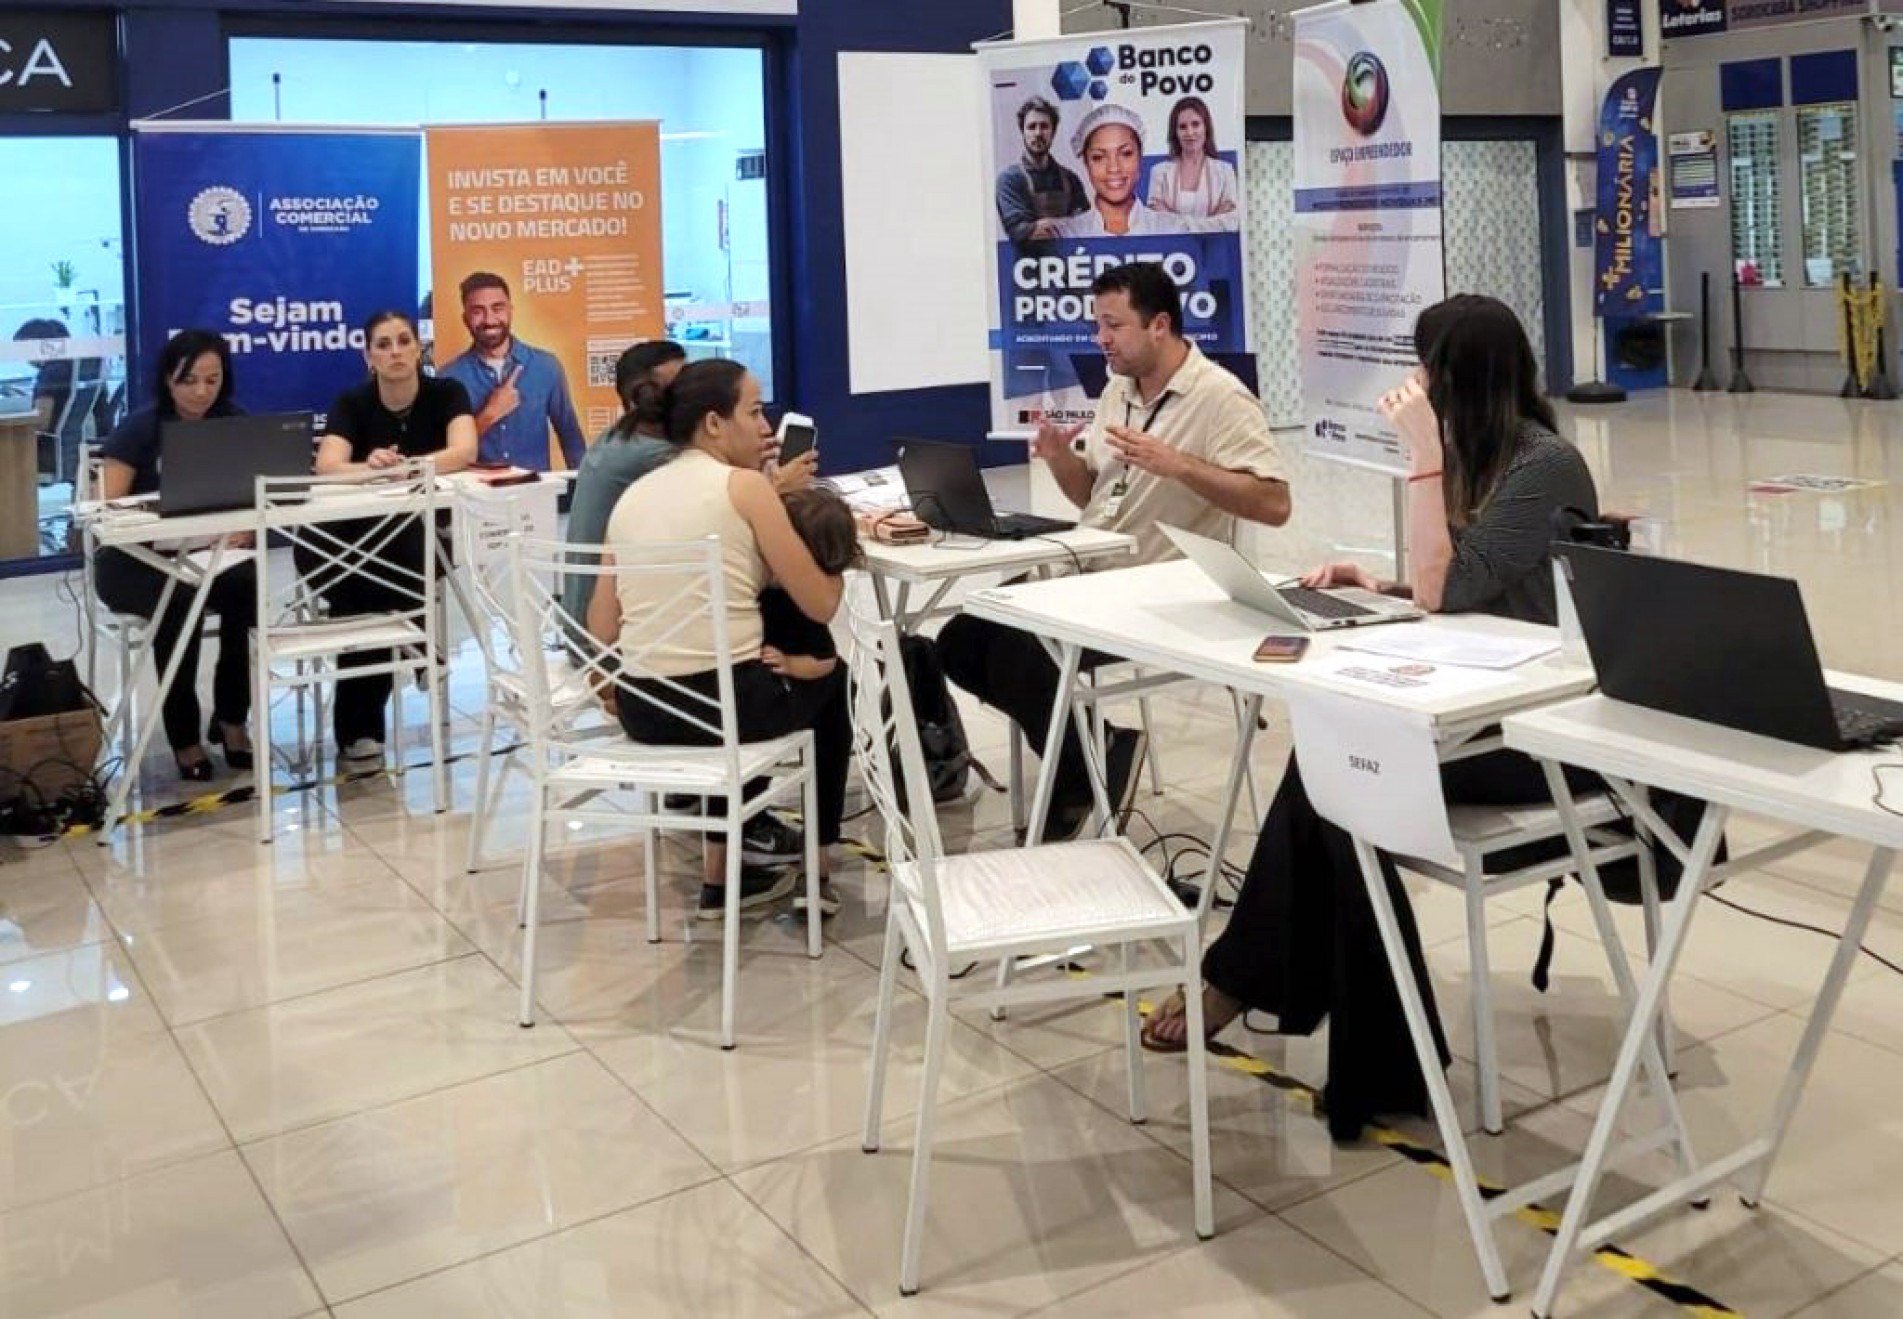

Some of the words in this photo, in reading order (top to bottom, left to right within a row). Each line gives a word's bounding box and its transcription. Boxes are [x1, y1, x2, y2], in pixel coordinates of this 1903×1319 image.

[1663, 8, 1722, 28] Loterias
[1118, 43, 1212, 70] Banco
[1119, 73, 1136, 84] do
[1140, 71, 1214, 97] Povo
[448, 169, 532, 190] INVISTA
[536, 168, 569, 187] EM
[573, 159, 630, 185] VOCÊ
[269, 194, 380, 211] ASSOCIAÇÃO
[449, 196, 462, 215] E
[467, 196, 494, 215] SE
[499, 193, 609, 215] DESTAQUE
[613, 191, 644, 209] NO
[275, 211, 373, 224] COMERCIAL
[451, 221, 512, 242] NOVO
[517, 217, 627, 239] MERCADO!
[522, 259, 562, 276] EAD
[1013, 247, 1197, 290] CRÉO
[524, 275, 572, 294] PLUS
[229, 297, 342, 328] Sejam
[168, 323, 366, 354] m-vindo
[1349, 755, 1381, 774] SEFAZ
